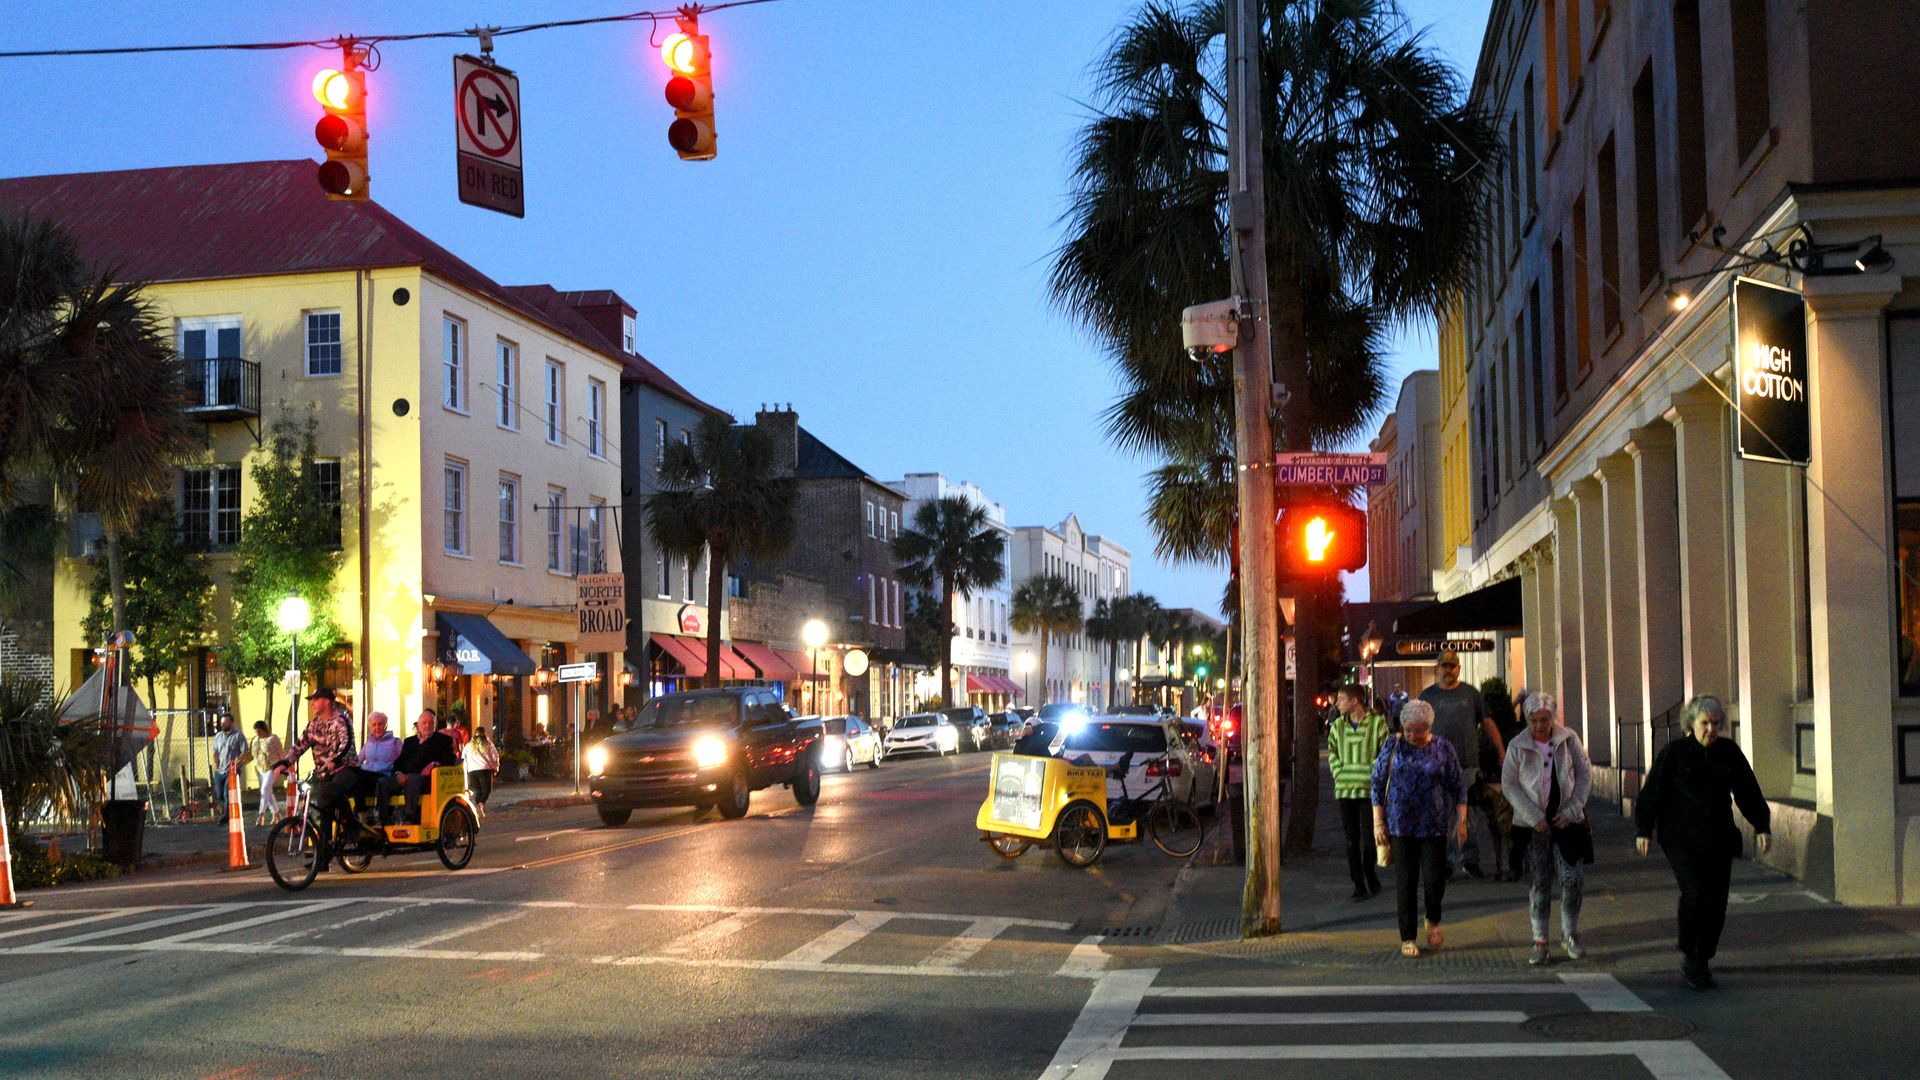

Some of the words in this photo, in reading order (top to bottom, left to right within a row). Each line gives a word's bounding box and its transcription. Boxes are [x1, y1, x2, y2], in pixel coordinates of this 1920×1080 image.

[466, 166, 486, 191] ON
[492, 173, 518, 200] RED
[1753, 343, 1791, 372] HIGH
[1744, 370, 1803, 402] COTTON
[1278, 465, 1370, 484] CUMBERLAND
[1370, 468, 1383, 481] ST
[578, 576, 622, 584] SLIGHTLY
[579, 586, 622, 598] NORTH
[579, 608, 623, 633] BROAD
[1410, 641, 1437, 652] HIGH
[1440, 640, 1482, 652] COTTON
[1087, 769, 1104, 777] TAXI
